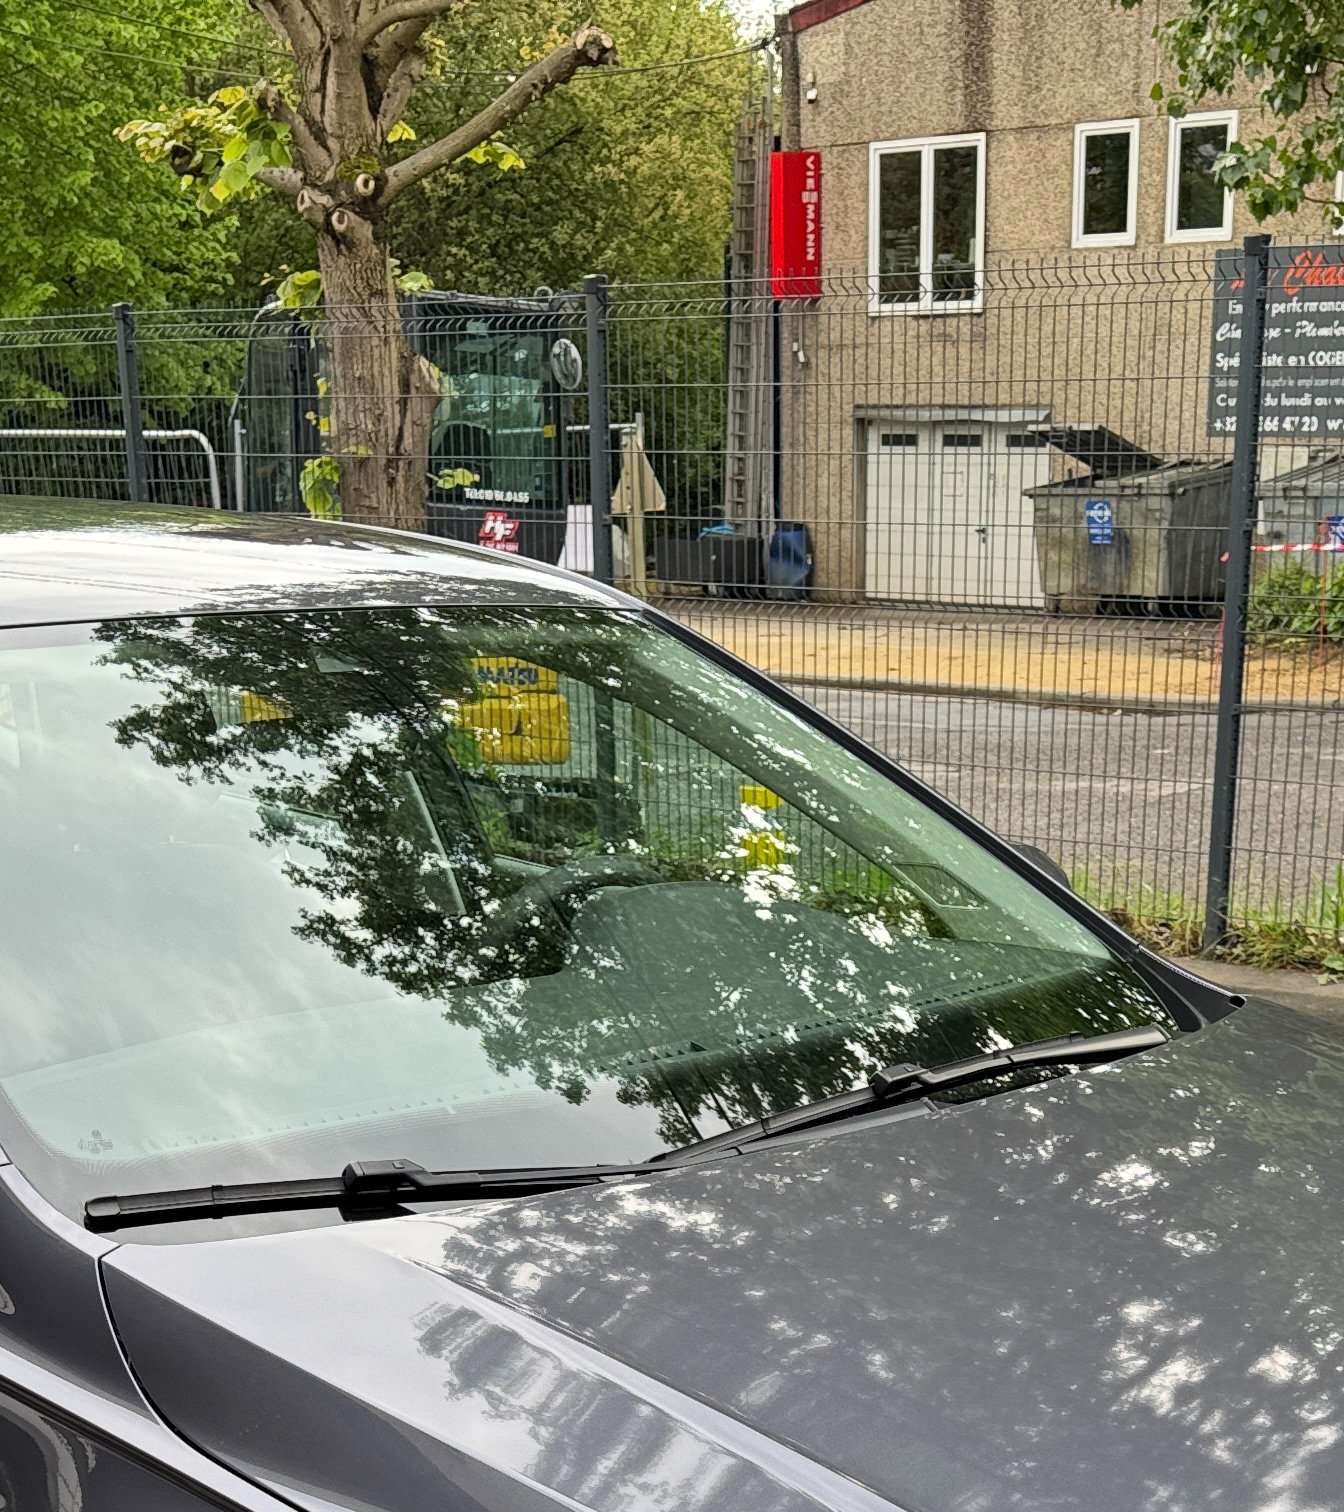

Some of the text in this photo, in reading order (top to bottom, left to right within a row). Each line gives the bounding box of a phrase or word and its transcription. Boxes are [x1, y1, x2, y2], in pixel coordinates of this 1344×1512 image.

[1215, 322, 1282, 343] Chage
[1215, 351, 1285, 371] Spéiste
[1287, 355, 1306, 367] en
[1264, 392, 1277, 407] du
[1280, 392, 1312, 407] lundi
[1314, 396, 1330, 407] au
[1301, 416, 1319, 433] 20
